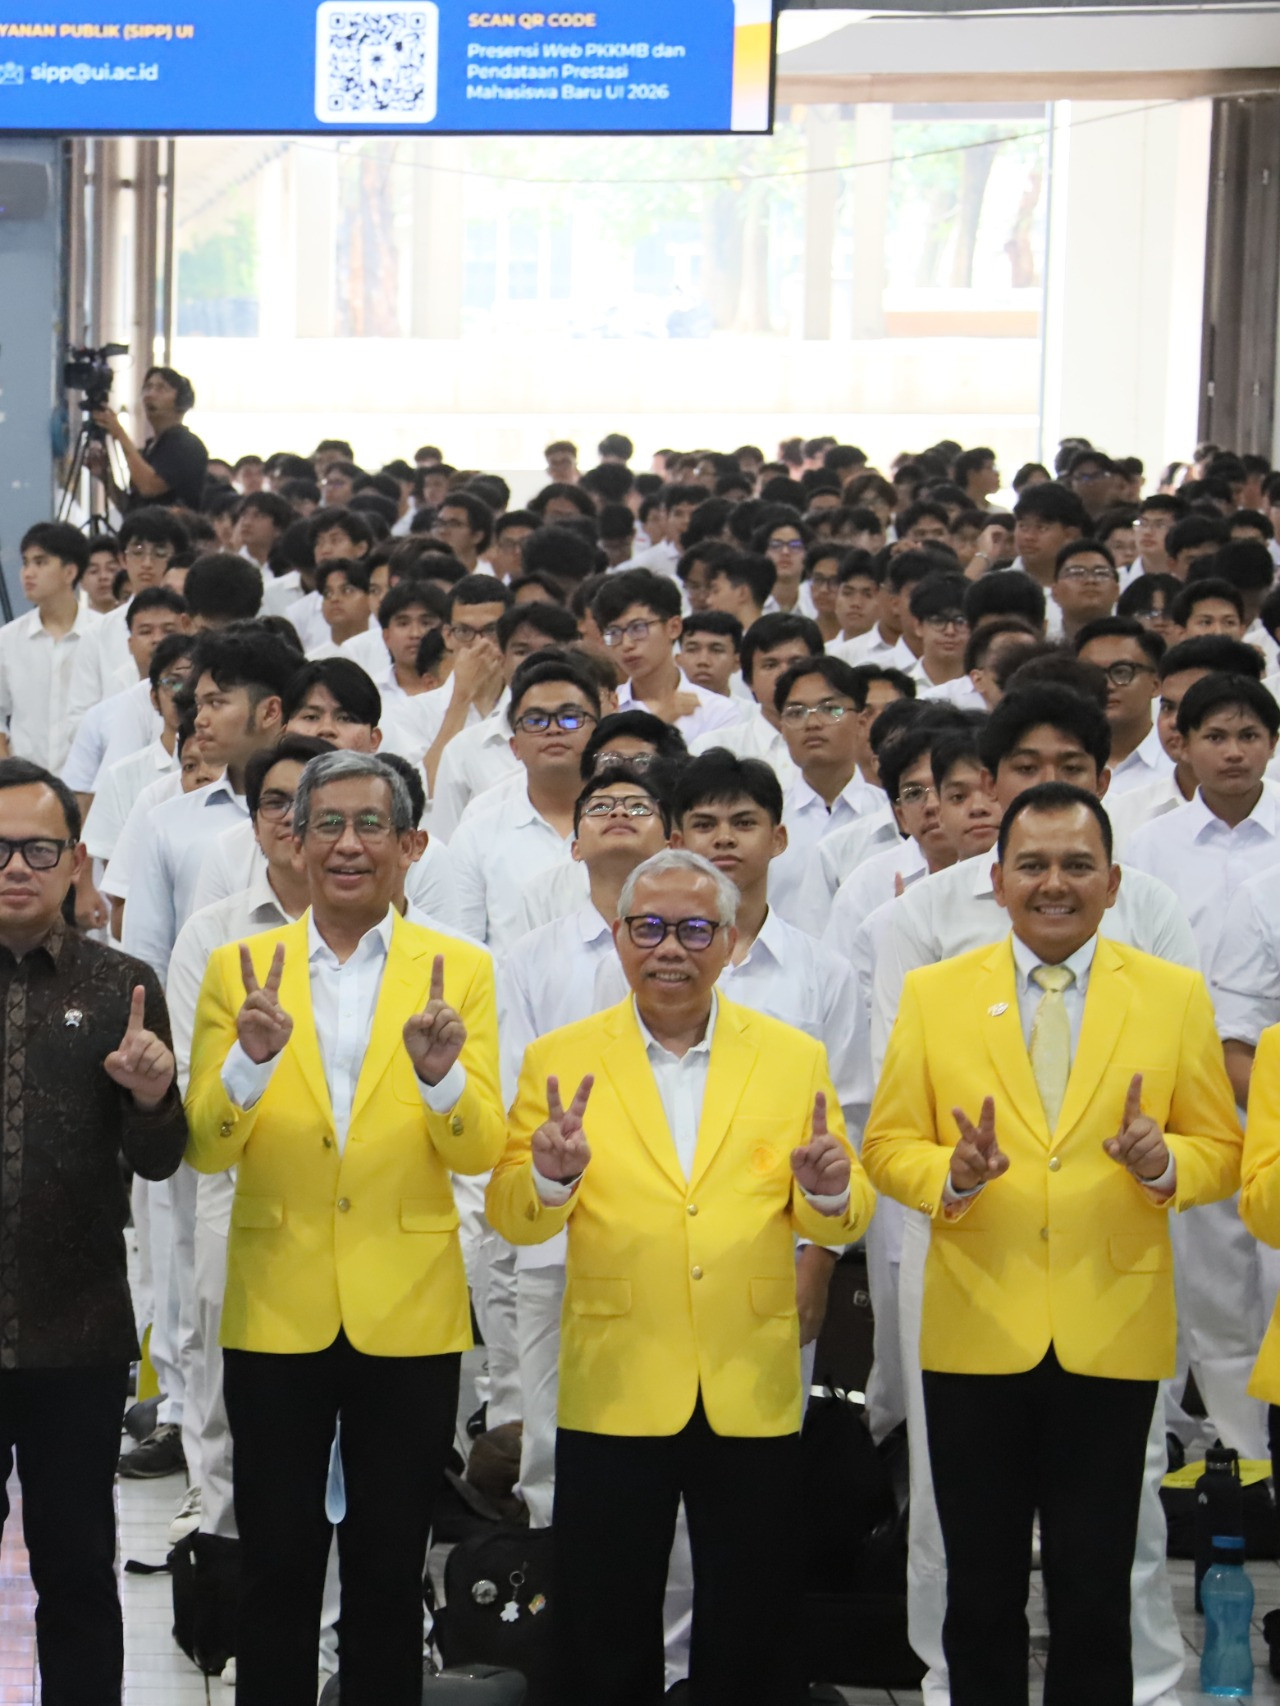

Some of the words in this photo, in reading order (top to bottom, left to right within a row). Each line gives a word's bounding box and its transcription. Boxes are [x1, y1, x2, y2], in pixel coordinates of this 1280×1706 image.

[467, 13, 515, 27] SCAN
[518, 13, 545, 30] QR
[548, 13, 596, 27] CODE
[59, 24, 120, 38] PUBLIK
[123, 24, 173, 41] (SIPP)
[175, 25, 194, 39] UI
[467, 43, 539, 58] Presensi
[543, 43, 582, 58] Web
[585, 42, 649, 58] PKKMB
[652, 43, 686, 58] dan
[30, 62, 159, 85] sipp@ui.ac.id
[466, 63, 558, 79] Pendataan
[561, 63, 629, 79] Prestasi
[466, 84, 558, 100] Mahasiswa
[561, 84, 602, 100] Baru
[605, 84, 624, 99] UI
[627, 83, 670, 99] 2026
